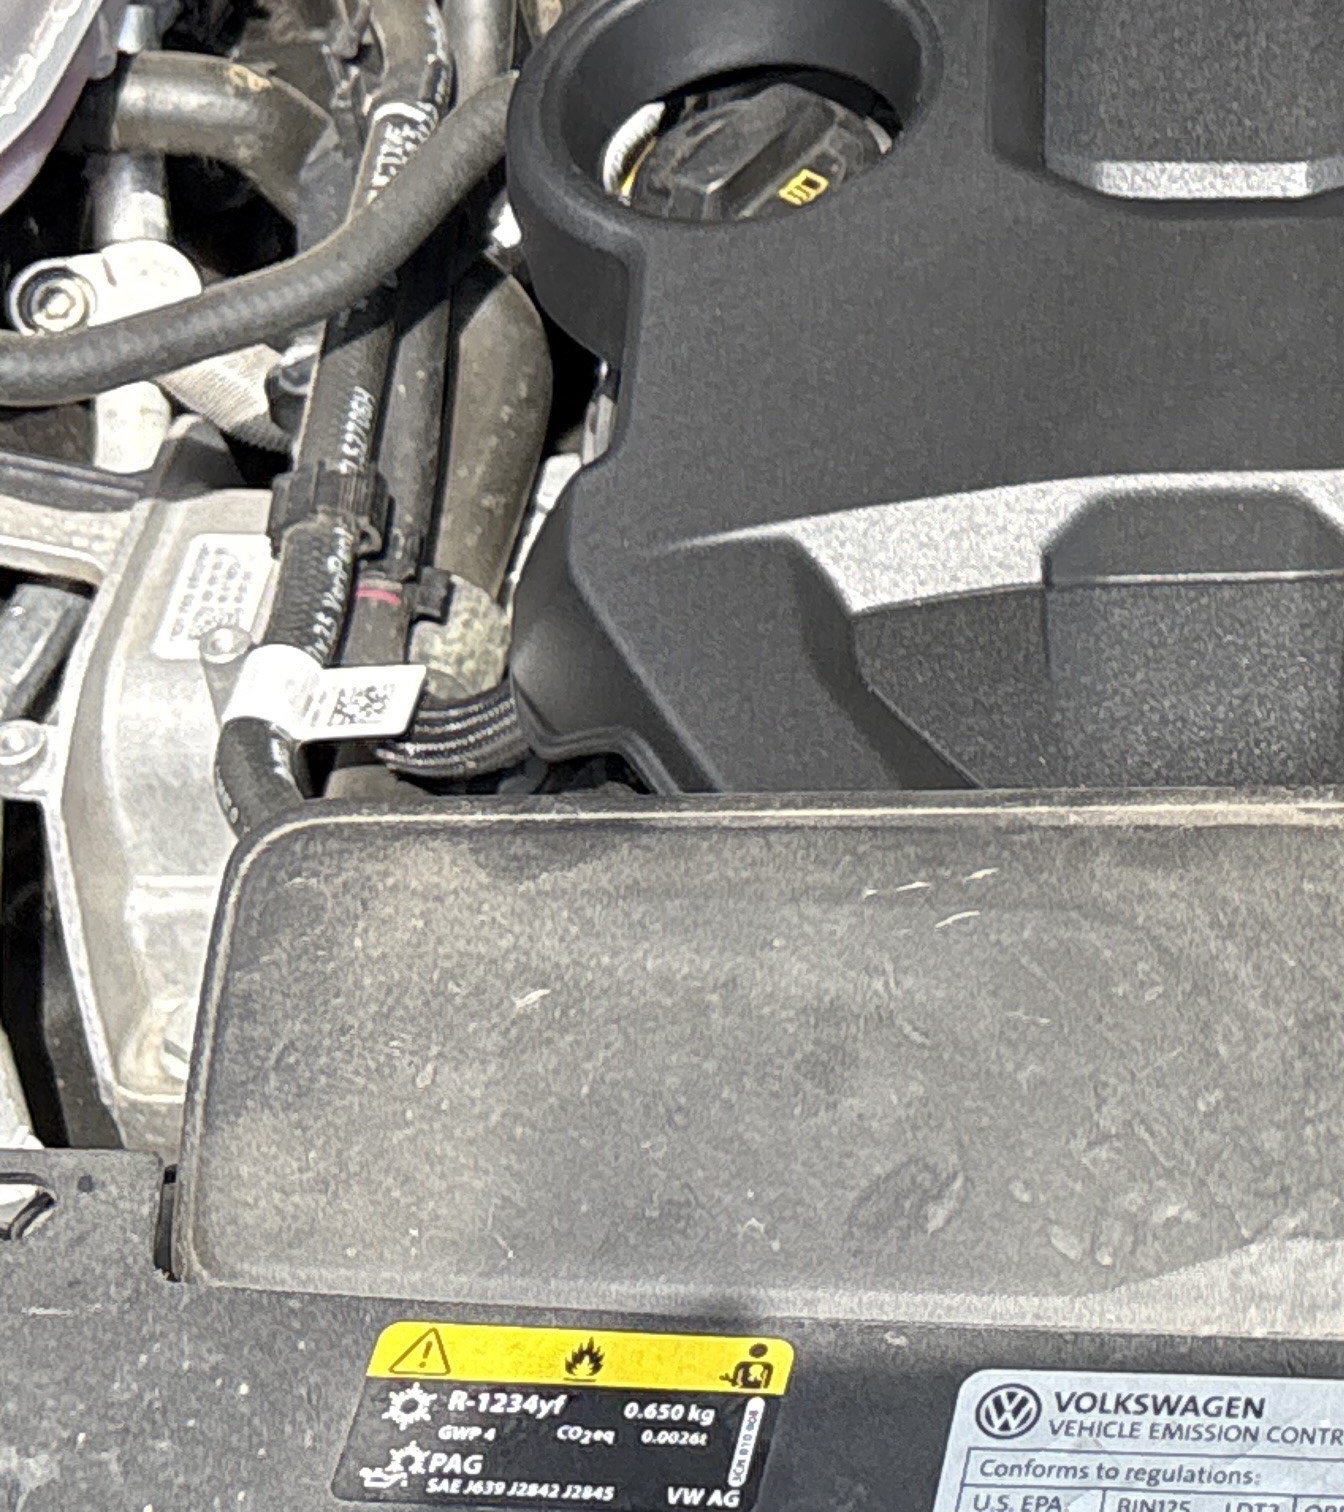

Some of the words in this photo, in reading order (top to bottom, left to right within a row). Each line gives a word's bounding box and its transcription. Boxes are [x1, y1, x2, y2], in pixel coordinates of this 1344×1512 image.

[447, 1389, 568, 1419] R-1234yf
[623, 1401, 684, 1420] 0.650
[687, 1403, 715, 1426] kg
[1053, 1391, 1266, 1419] VOLKSWAGEN
[438, 1425, 482, 1441] GWP
[484, 1427, 497, 1441] 4
[1048, 1419, 1141, 1439] VEHICLE
[1149, 1422, 1260, 1444] EMISSION
[428, 1452, 484, 1475] PAG
[979, 1459, 1089, 1480] Conforms
[1096, 1461, 1120, 1481] to
[1125, 1463, 1262, 1487] regulations:
[425, 1477, 462, 1494] SAE
[463, 1480, 506, 1496] J639
[667, 1487, 706, 1506] VW
[706, 1489, 741, 1508] AG
